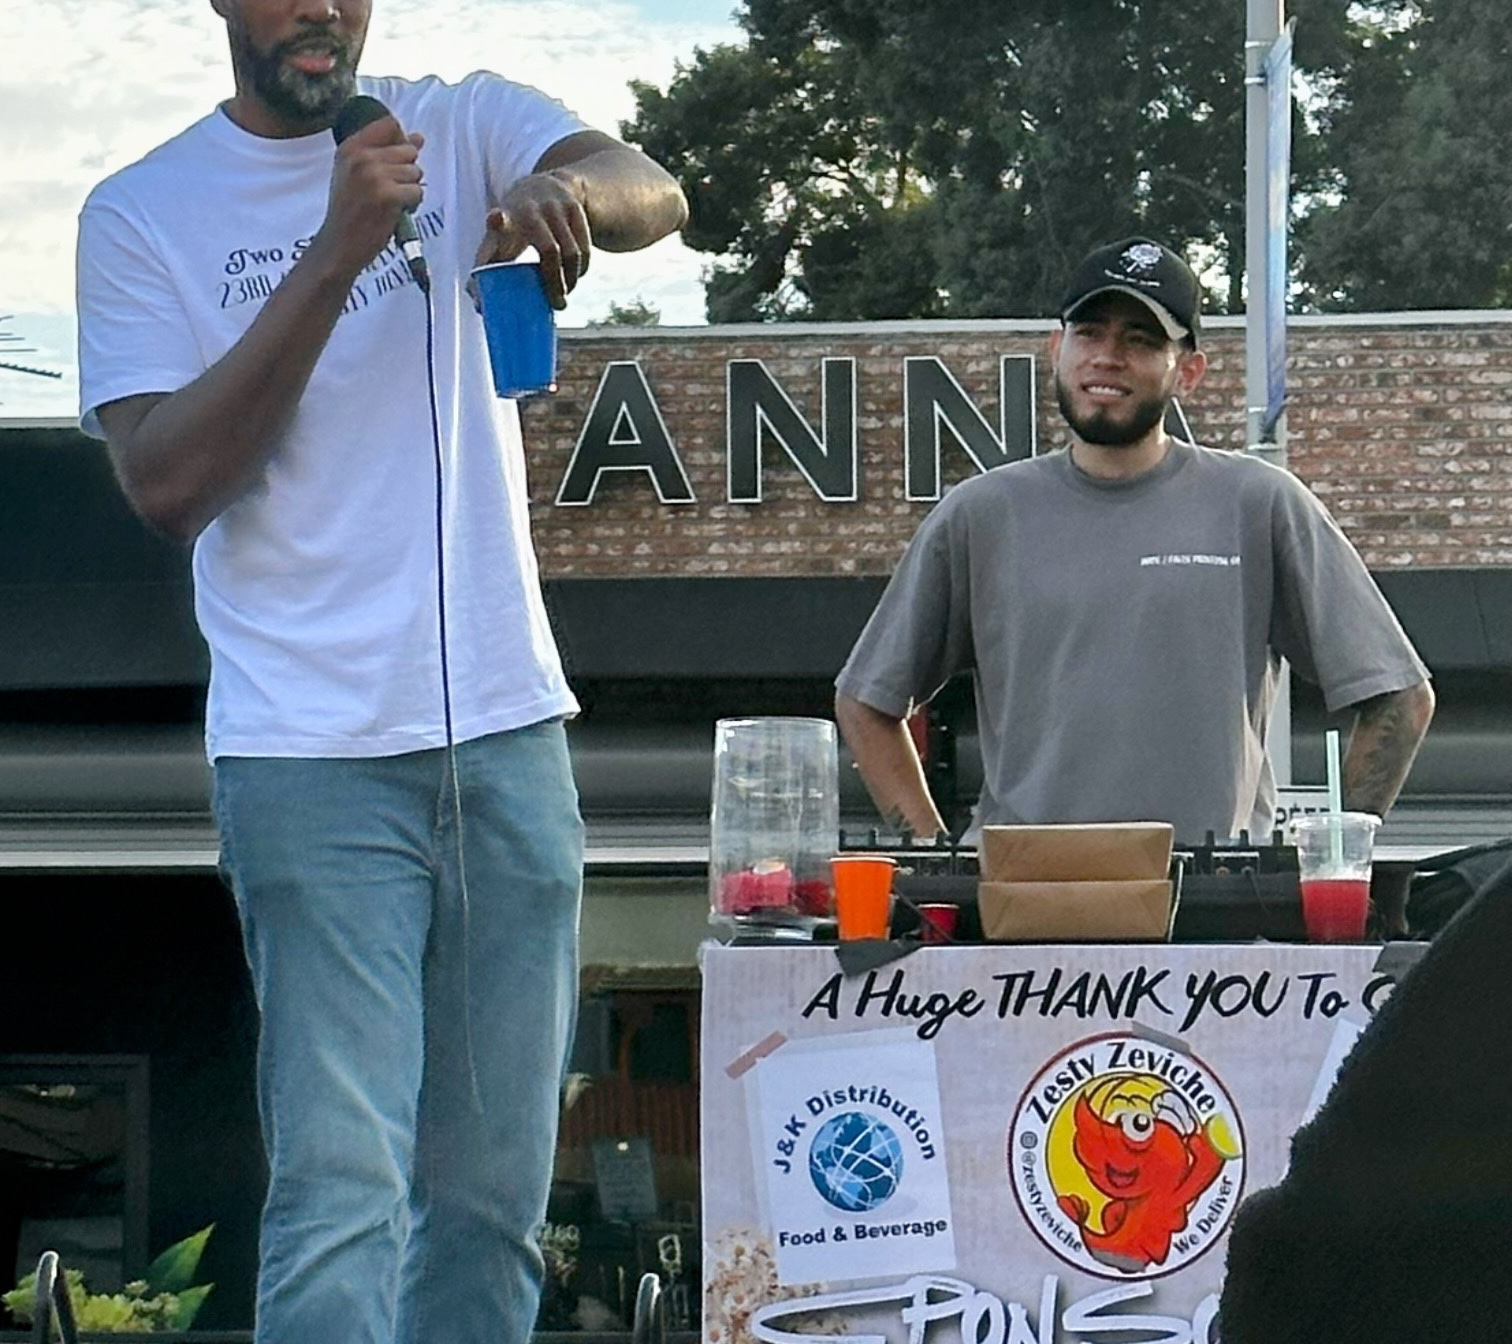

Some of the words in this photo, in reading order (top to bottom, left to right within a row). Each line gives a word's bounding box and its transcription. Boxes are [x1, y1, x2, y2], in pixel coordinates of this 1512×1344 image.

[225, 247, 284, 275] Two
[554, 353, 1200, 507] ANN
[802, 972, 839, 1019] A
[855, 969, 985, 1039] Huge
[992, 966, 1174, 1019] THANK
[1179, 970, 1290, 1033] YOU
[1297, 973, 1349, 1019] To
[1026, 1053, 1095, 1124] Zesty
[1106, 1041, 1216, 1113] Zeviche
[773, 1114, 807, 1175] J&K
[806, 1085, 936, 1160] Distribution
[779, 1227, 826, 1247] Food
[833, 1226, 848, 1242] &
[854, 1218, 948, 1241] Beverage
[1173, 1233, 1200, 1255] We
[1198, 1175, 1234, 1234] Deliver
